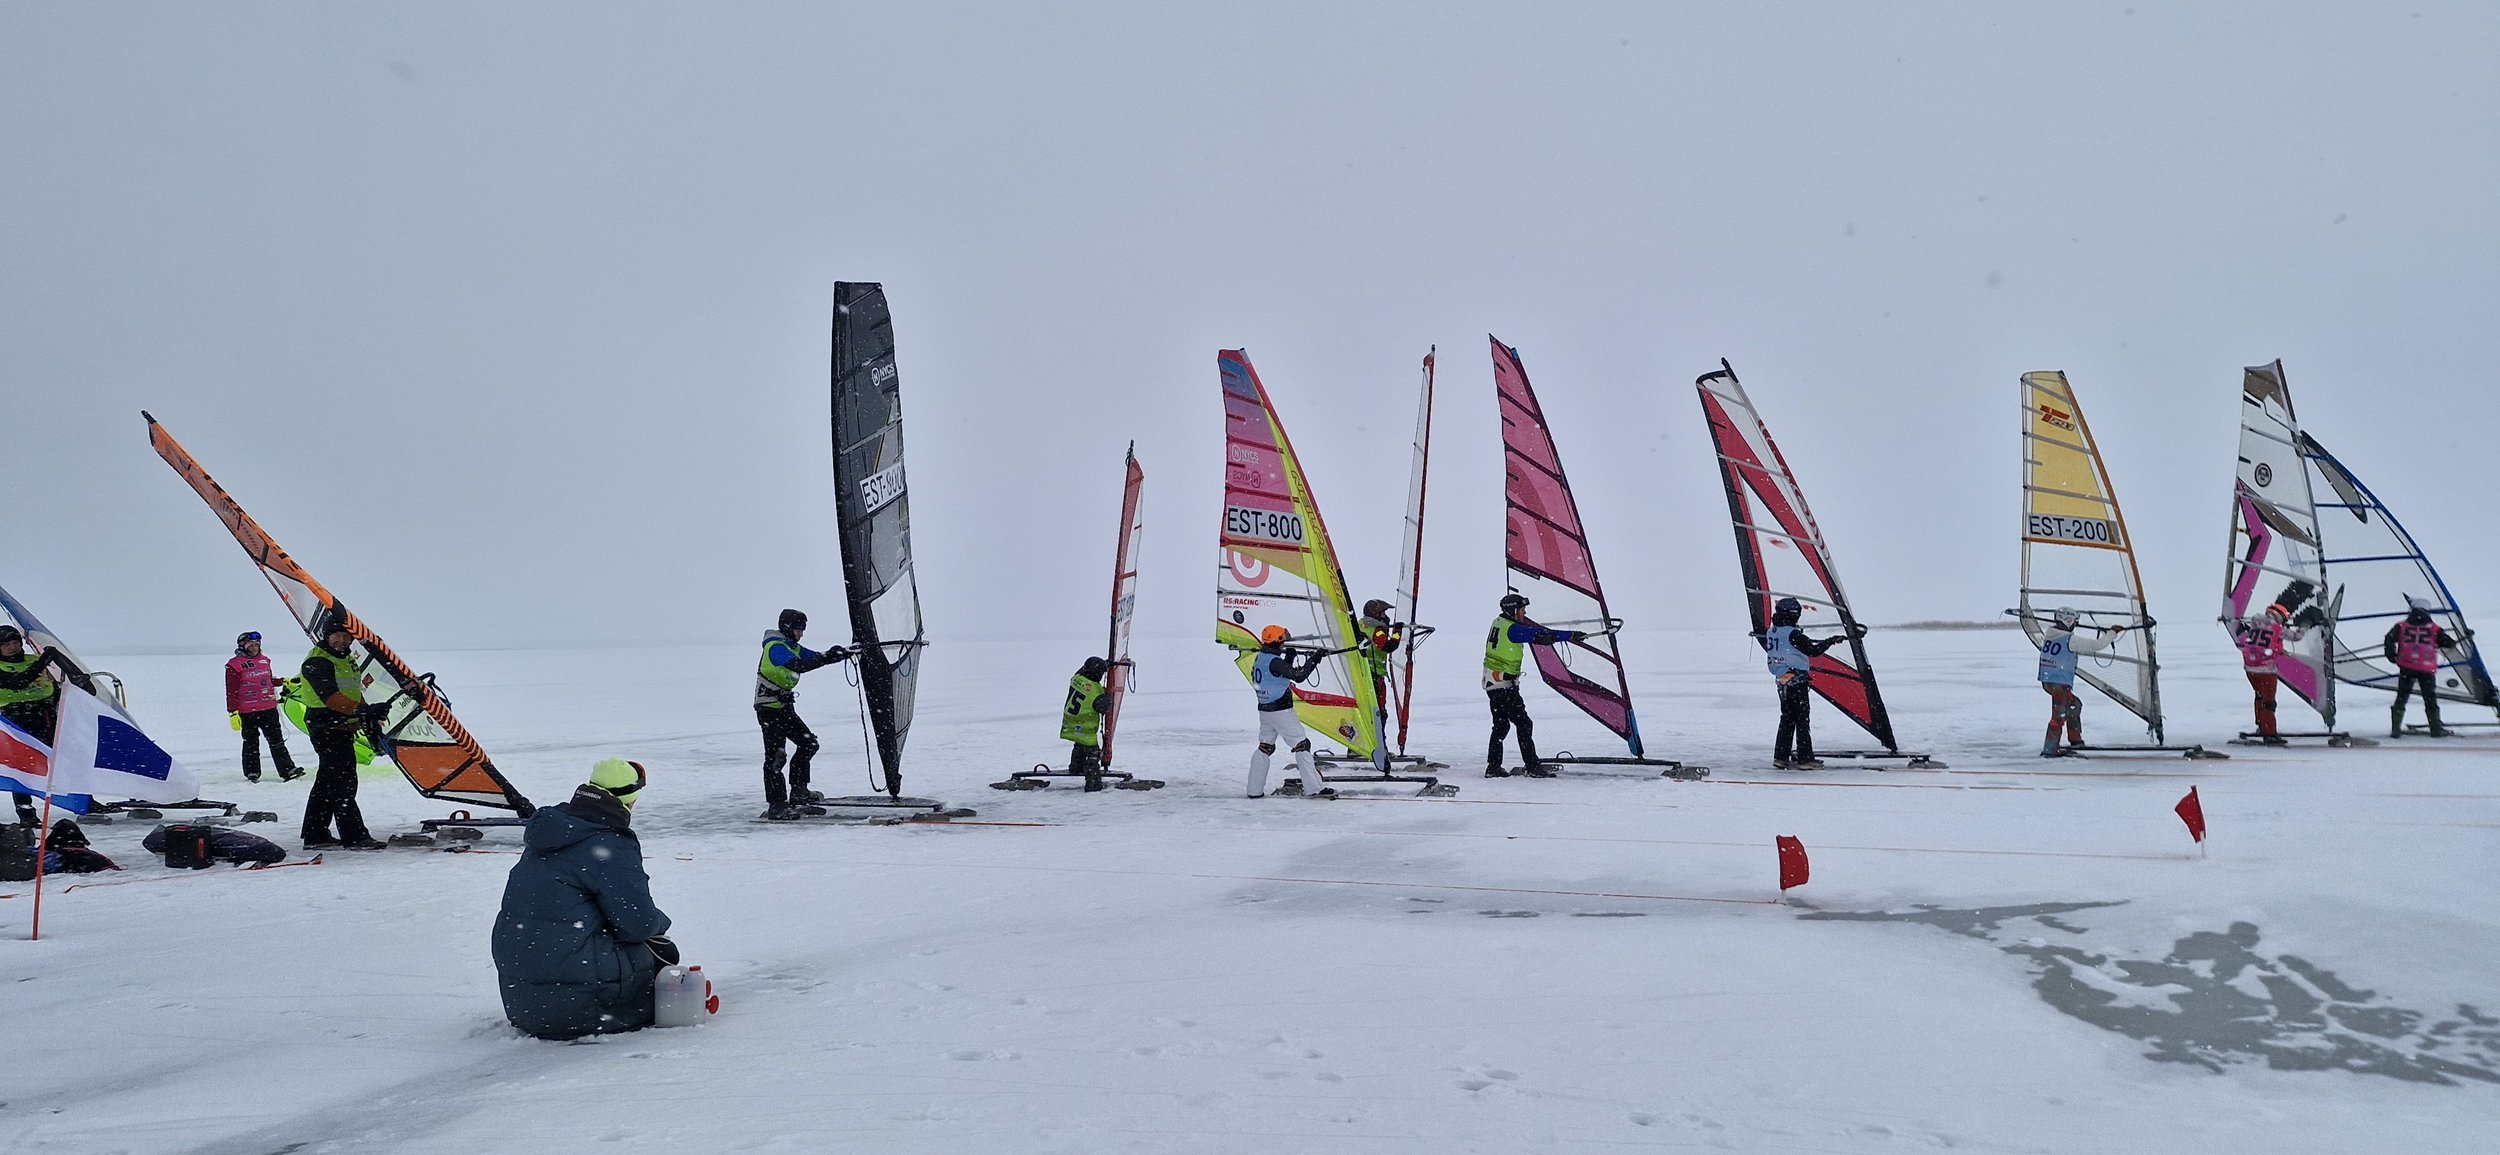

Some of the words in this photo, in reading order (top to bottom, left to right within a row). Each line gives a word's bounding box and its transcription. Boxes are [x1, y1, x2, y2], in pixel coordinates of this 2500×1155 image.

[880, 364, 895, 377] NYCS
[1227, 508, 1302, 541] EST-800
[2030, 516, 2107, 542] EST-200
[1487, 626, 1500, 650] 4
[2404, 627, 2432, 644] 52
[2043, 640, 2062, 656] 80
[241, 660, 255, 669] 46
